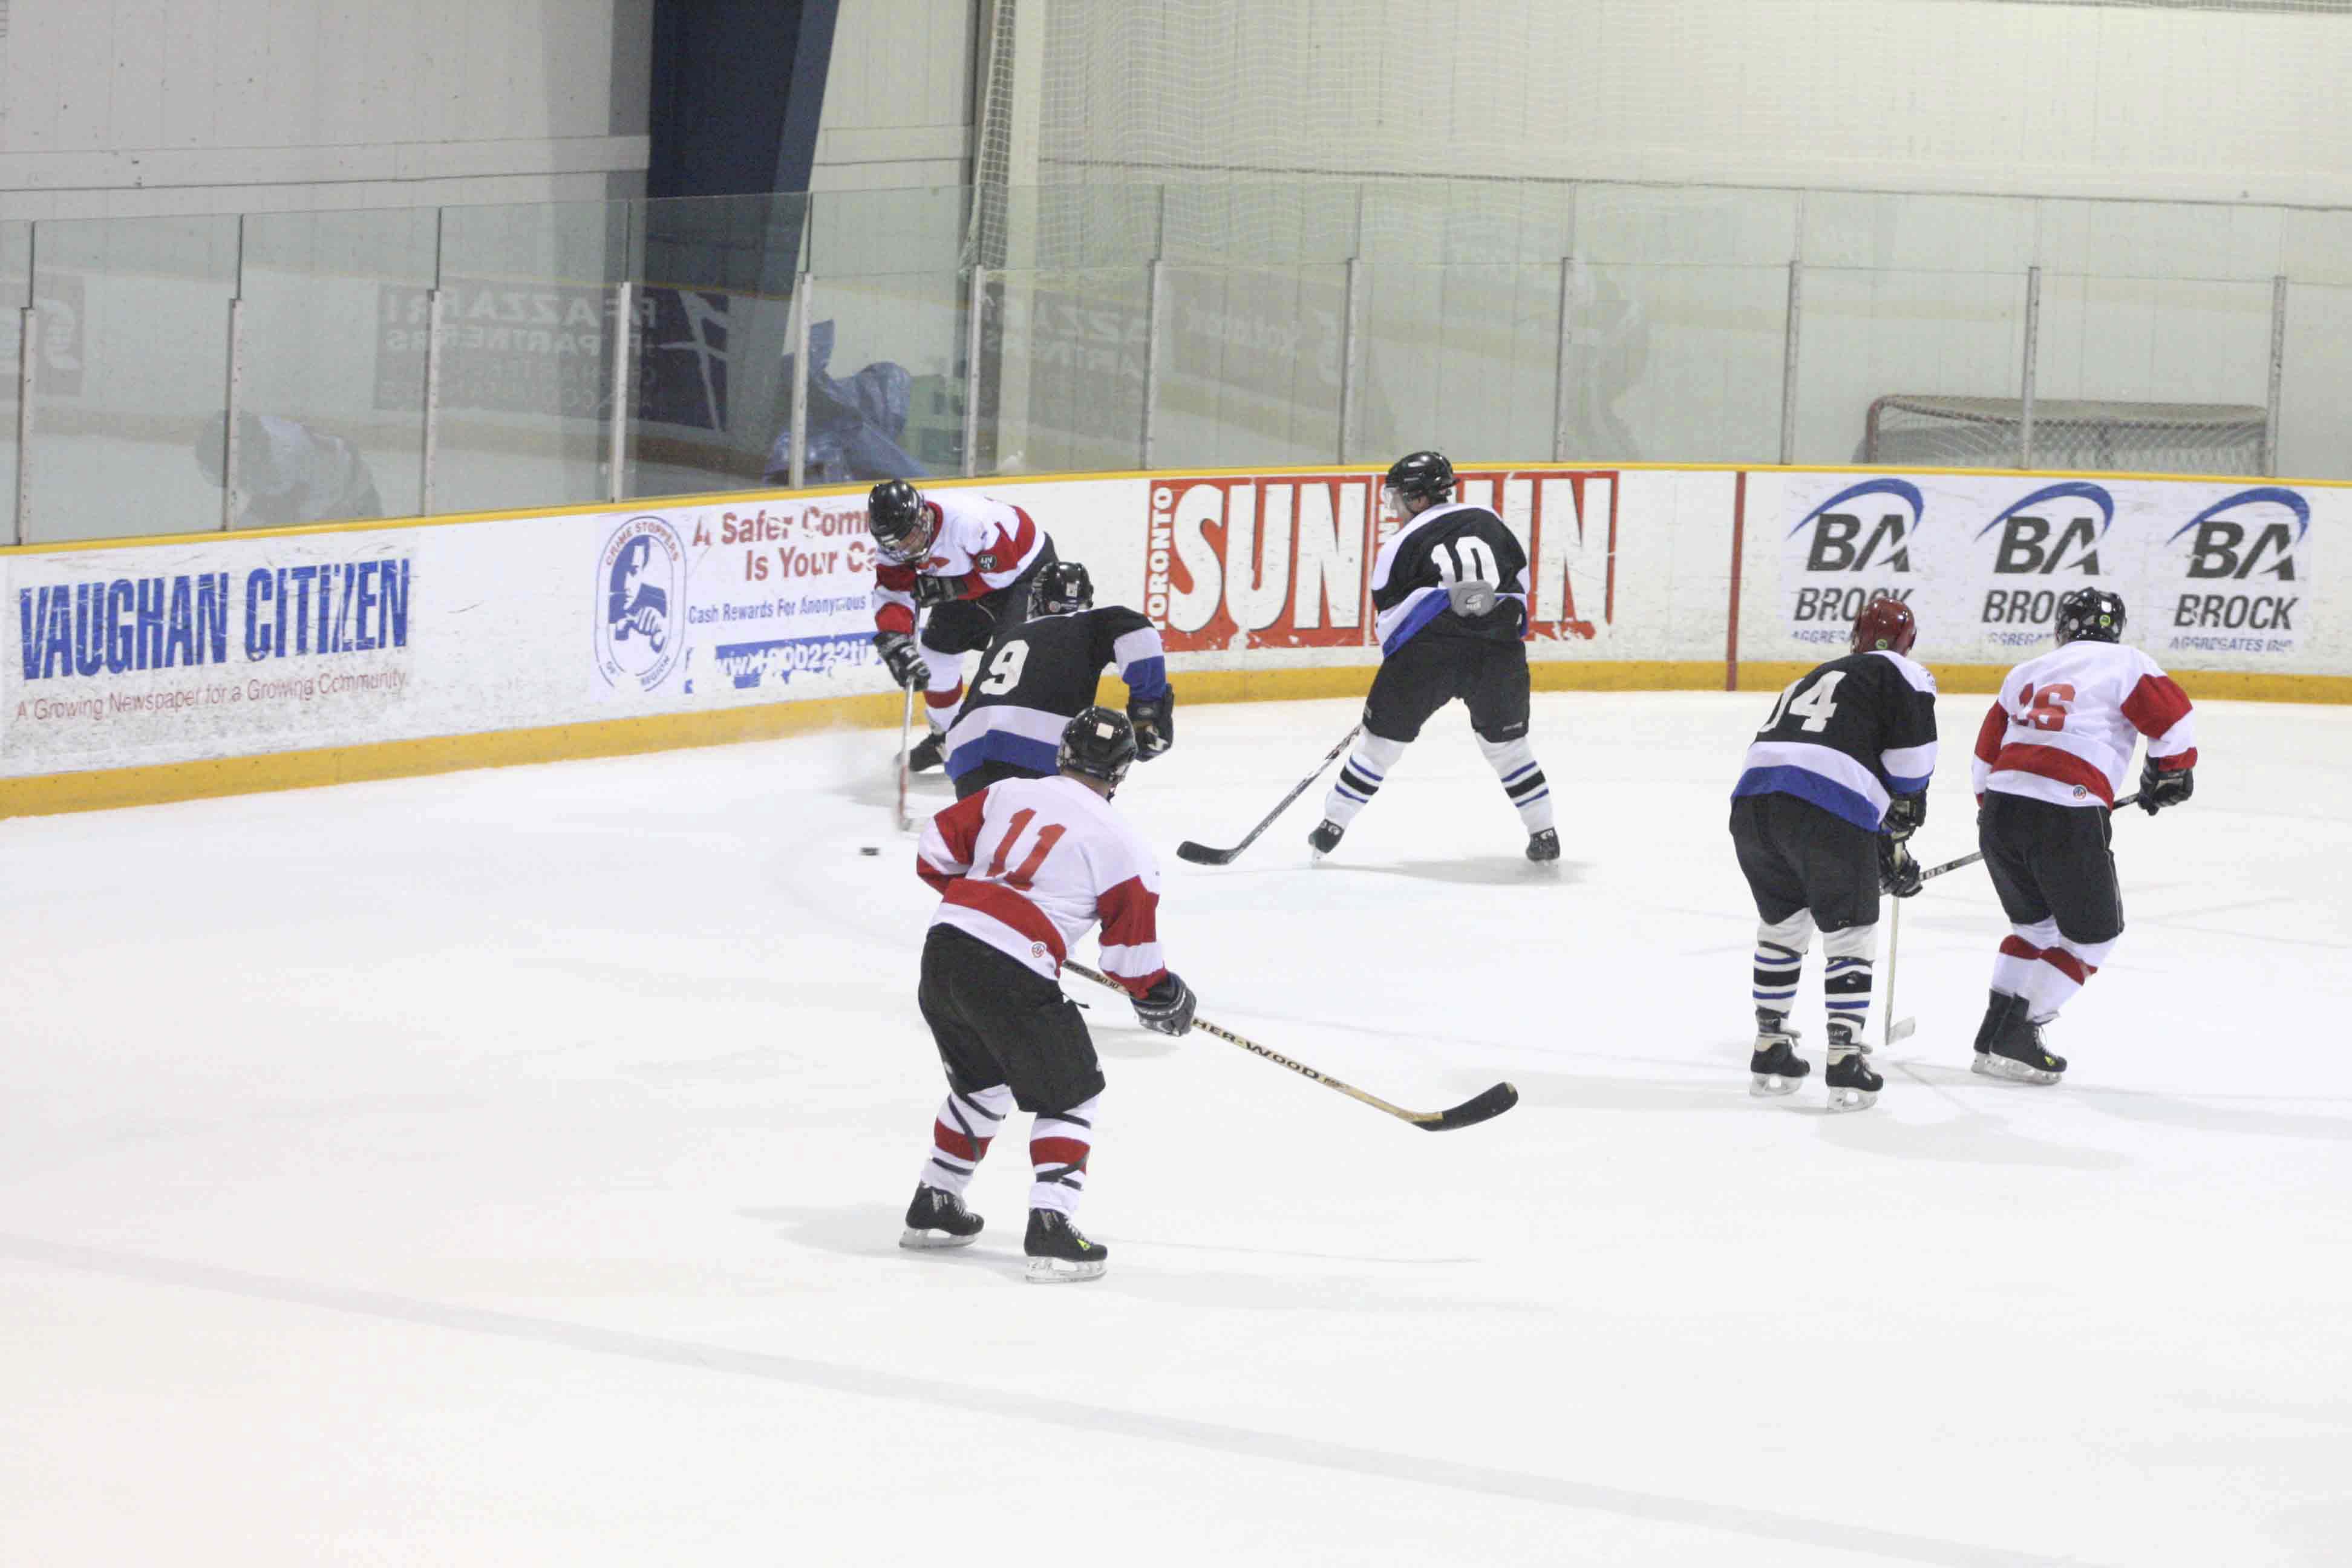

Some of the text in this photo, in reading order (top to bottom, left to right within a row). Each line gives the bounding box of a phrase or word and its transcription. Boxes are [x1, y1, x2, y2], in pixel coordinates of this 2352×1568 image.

[722, 509, 793, 544] Safer
[1806, 513, 1910, 573] BA
[1993, 516, 2100, 575] BA
[2185, 521, 2296, 581] BA
[746, 550, 768, 581] Is
[779, 546, 838, 578] Your
[1146, 486, 1174, 630] TORONTO
[1168, 482, 1365, 632] SUN
[1431, 536, 1500, 592] 10
[19, 558, 410, 680] VAUGHAN CITIZEN
[688, 605, 719, 624] Cash
[723, 603, 774, 622] Rewards
[777, 598, 796, 617] For
[2174, 593, 2299, 630] BROCK
[16, 668, 407, 720] A Growing Newspaper for a Growing Community
[979, 639, 1029, 695] 9
[985, 808, 1067, 892] 11
